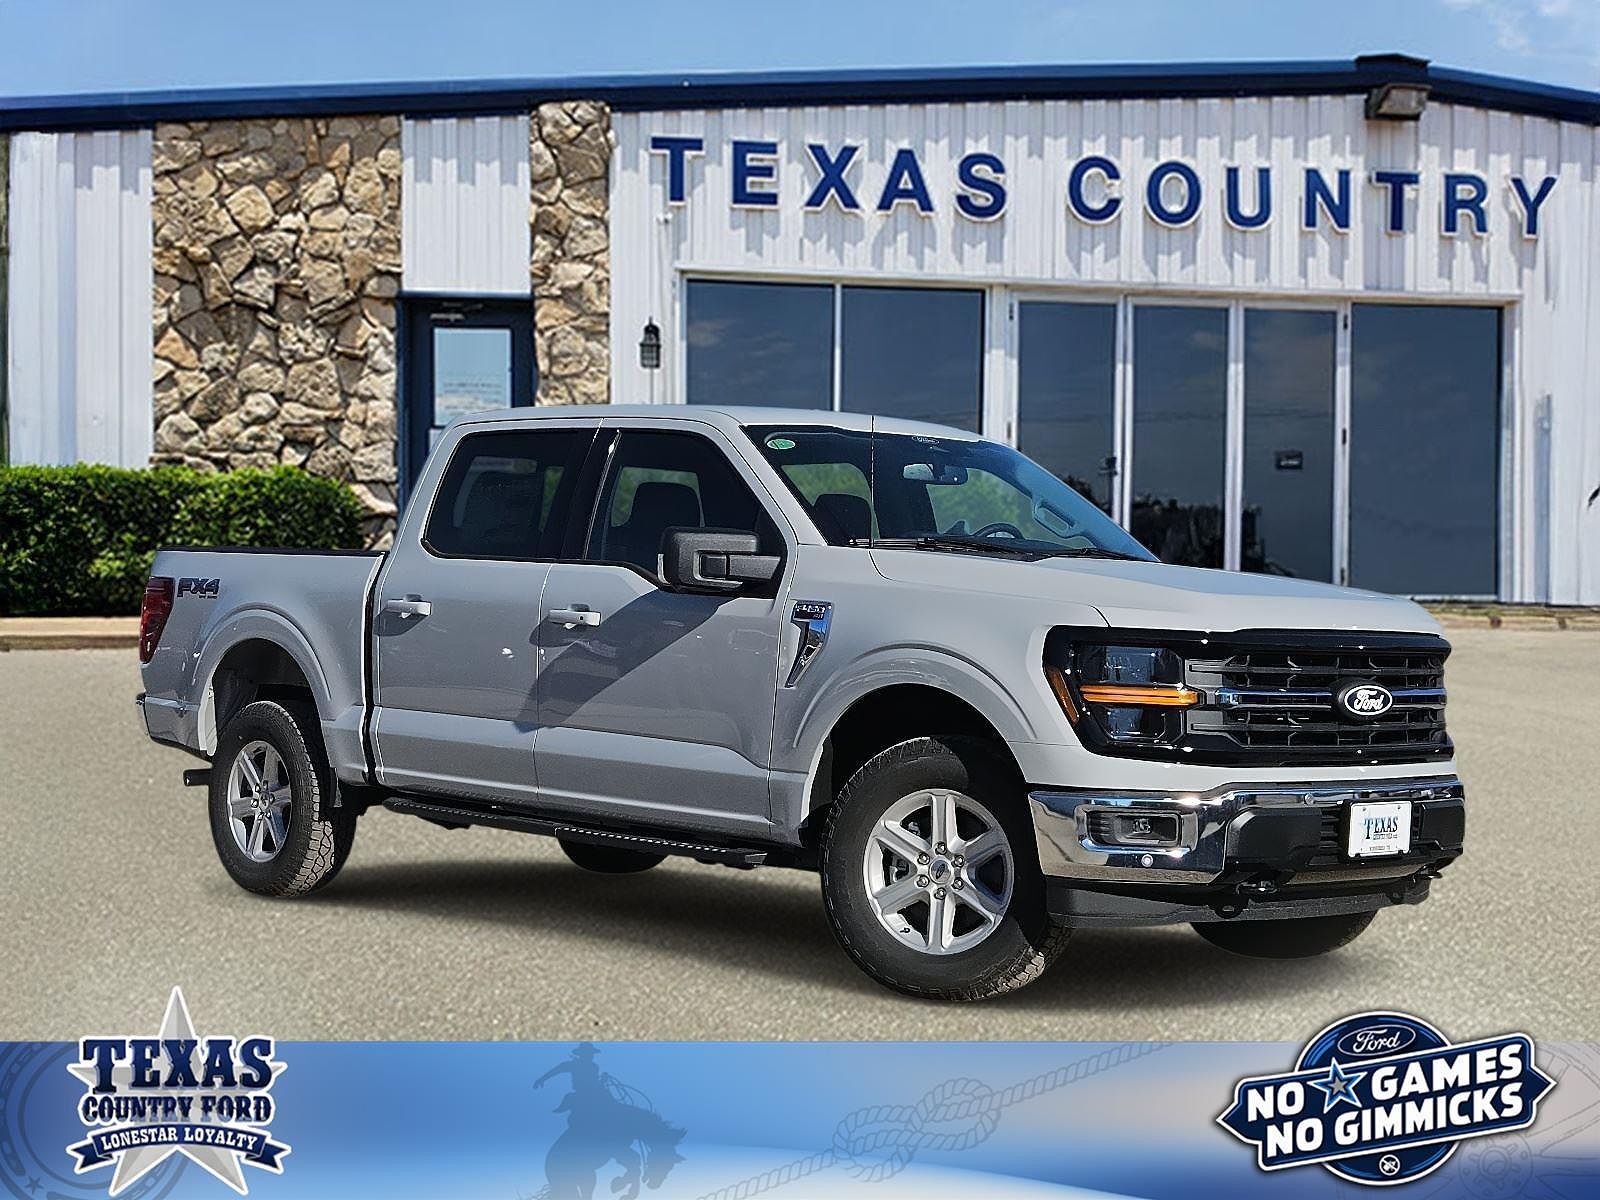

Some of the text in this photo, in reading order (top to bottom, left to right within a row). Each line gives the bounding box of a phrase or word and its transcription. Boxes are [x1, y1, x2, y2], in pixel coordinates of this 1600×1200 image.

[650, 135, 1556, 239] TEXAS COUNTRY
[177, 577, 220, 598] FX4
[1353, 689, 1385, 710] Ford
[1364, 816, 1398, 839] TEXAS
